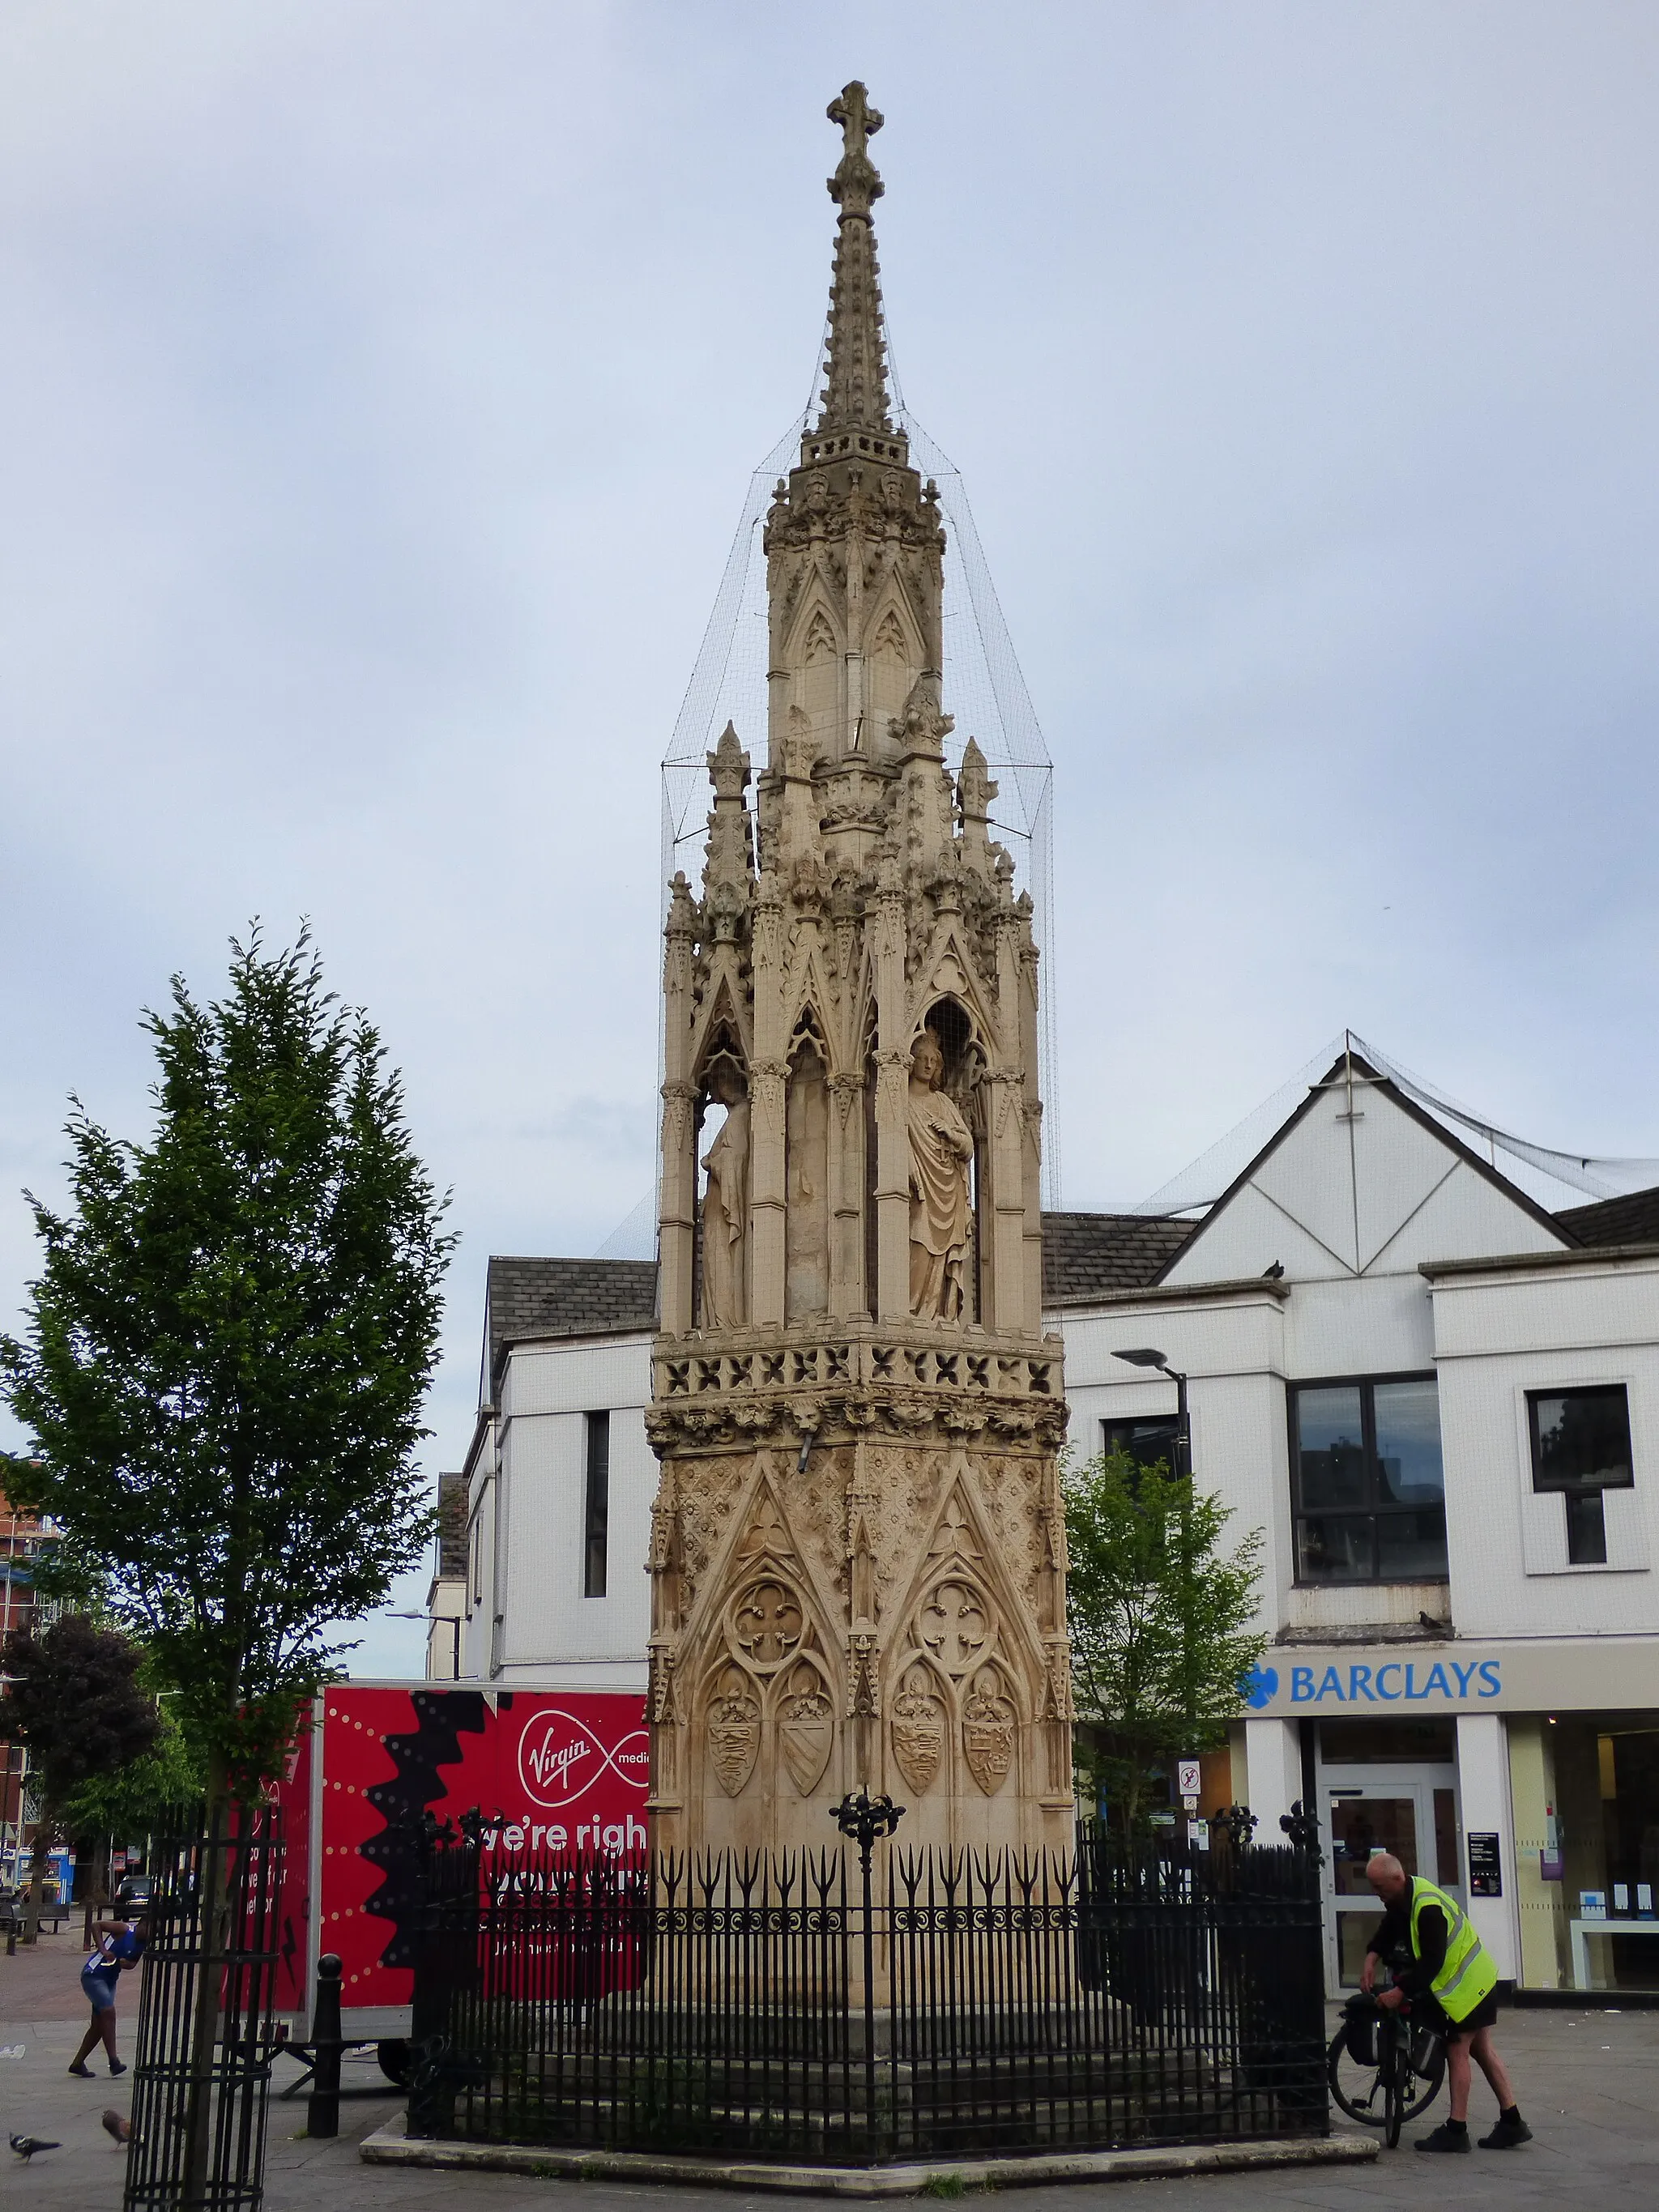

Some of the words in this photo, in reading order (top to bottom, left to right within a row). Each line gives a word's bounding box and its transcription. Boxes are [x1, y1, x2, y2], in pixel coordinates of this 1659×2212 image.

[1290, 1660, 1502, 1702] BARCLAYS
[528, 1727, 591, 1789] Virgin
[618, 1752, 650, 1764] medi
